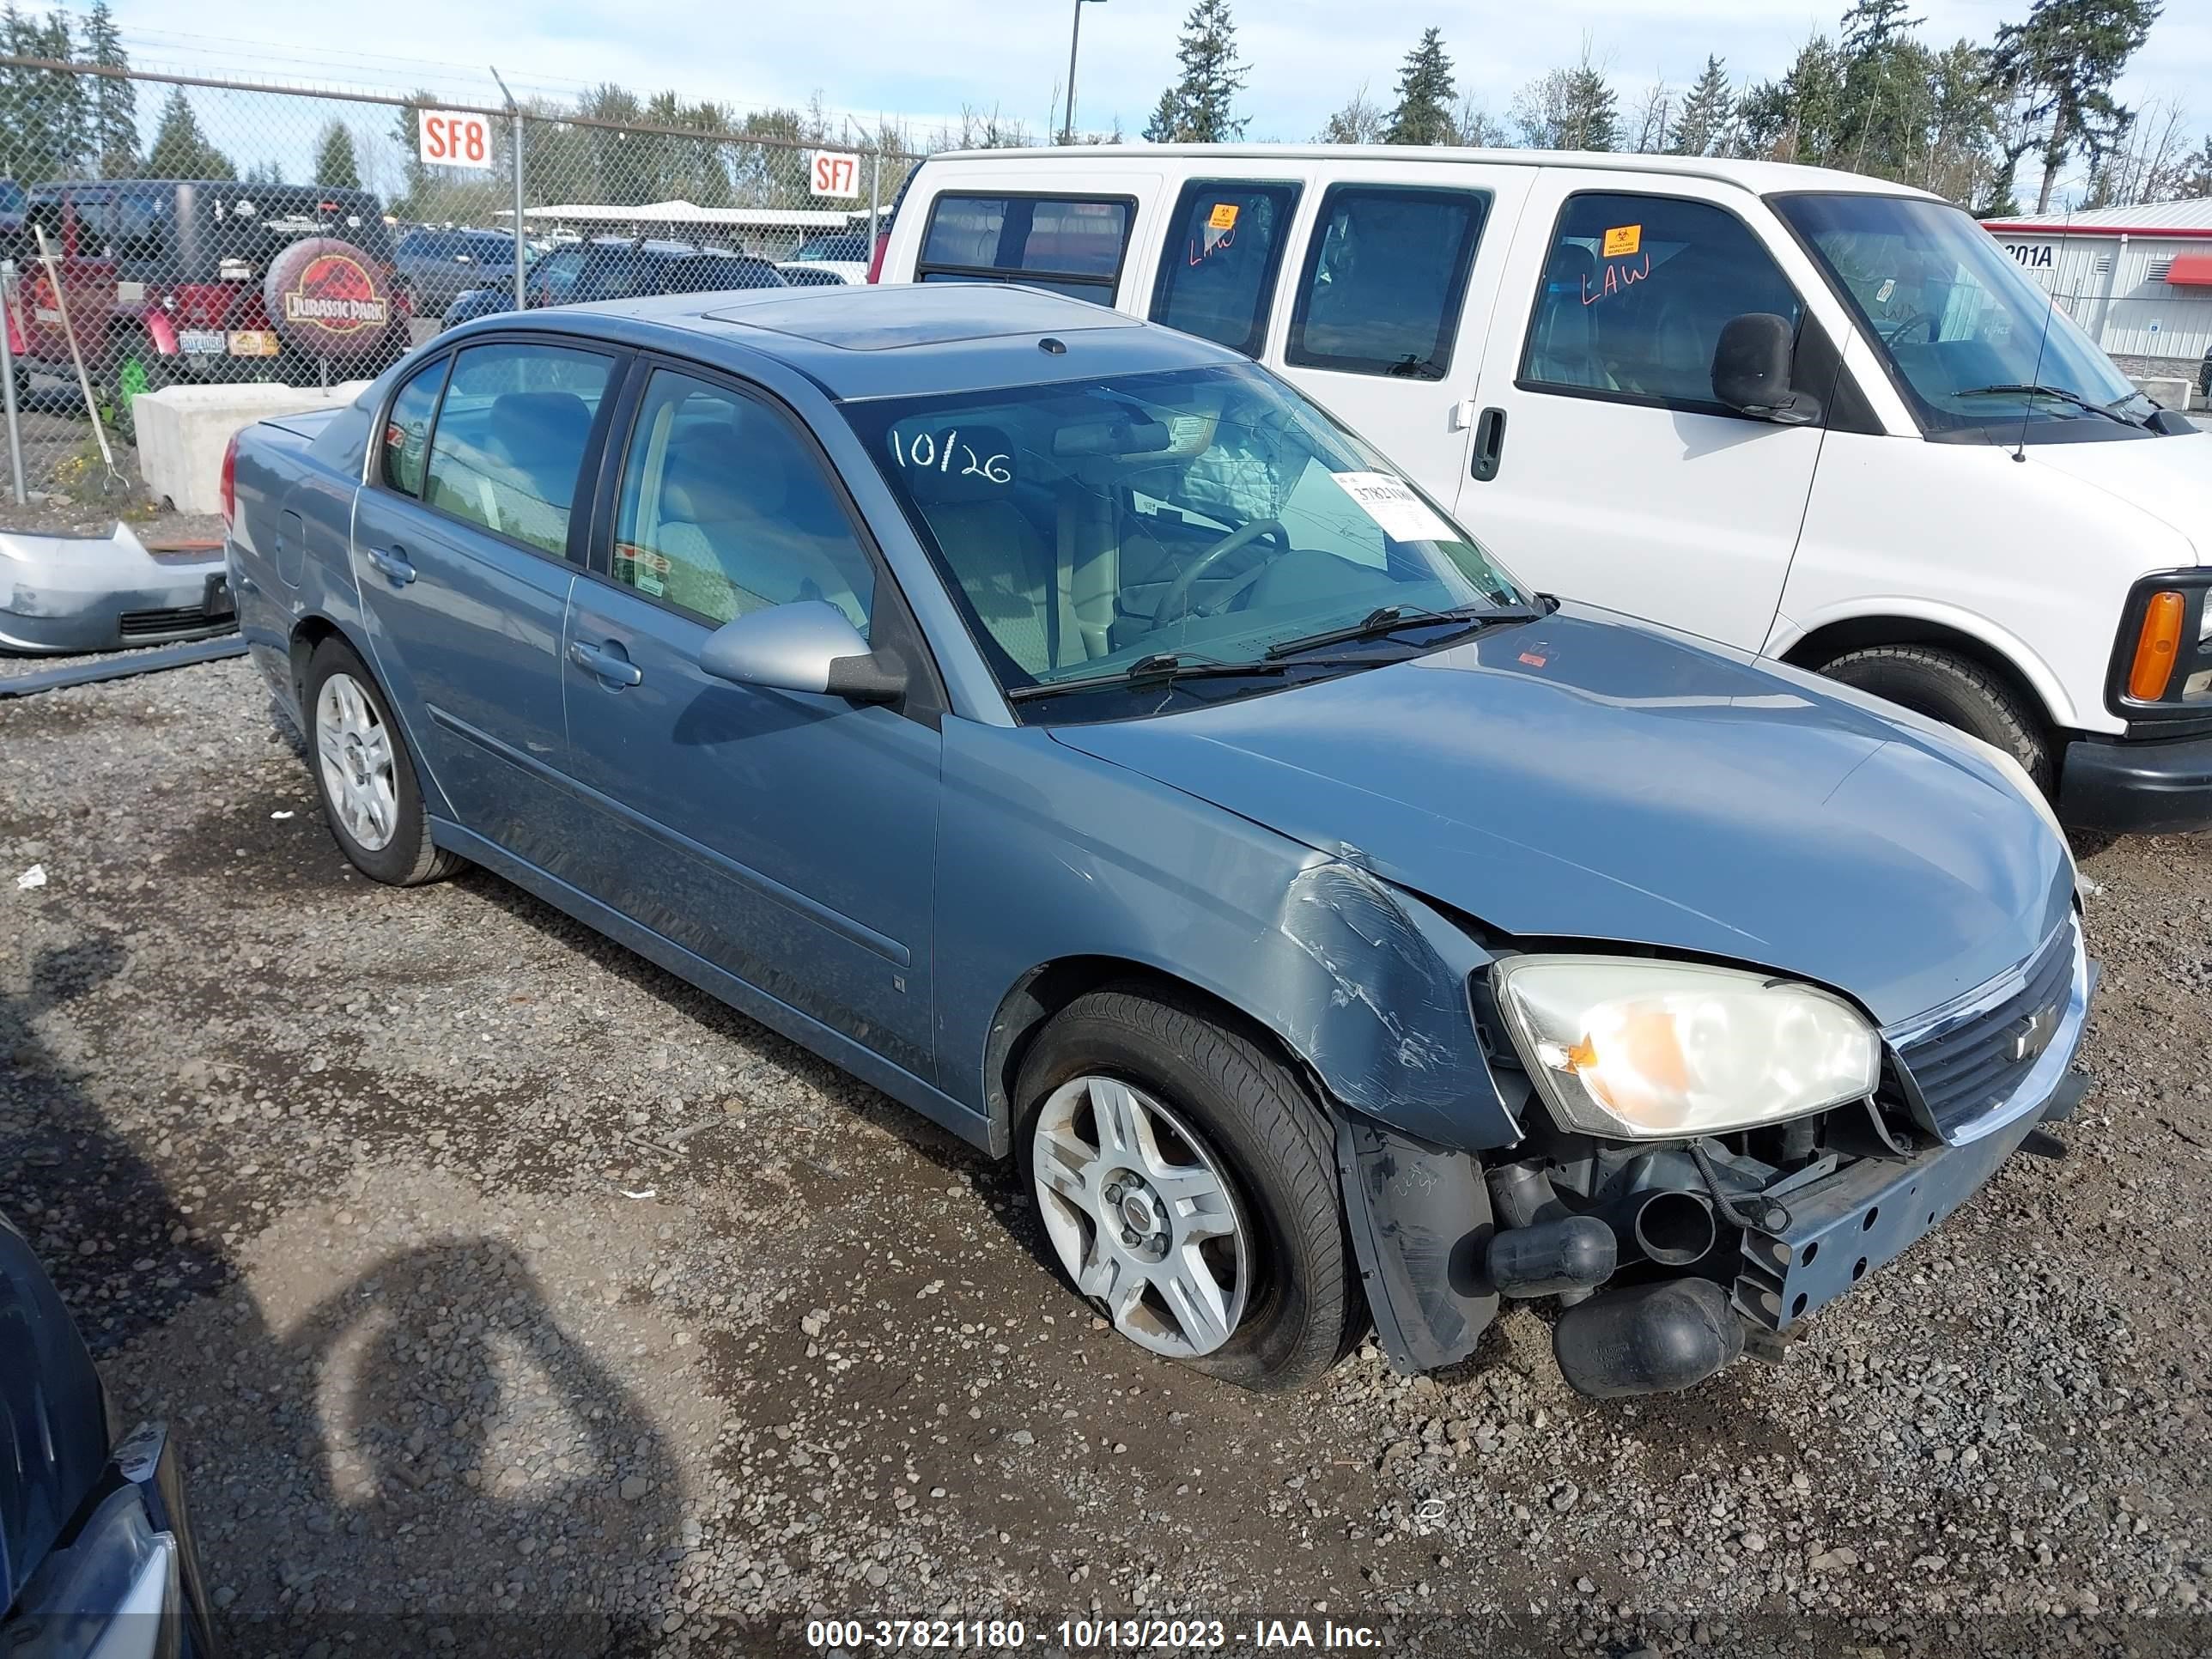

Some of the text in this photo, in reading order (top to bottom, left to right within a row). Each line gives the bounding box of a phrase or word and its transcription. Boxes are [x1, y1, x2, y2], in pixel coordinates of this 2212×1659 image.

[426, 117, 483, 161] SF8
[817, 157, 853, 192] SF7
[1190, 228, 1236, 266] LAW
[1582, 252, 1650, 305] LAW
[291, 296, 383, 320] JURASSIC PARK
[893, 429, 1011, 483] 10/26
